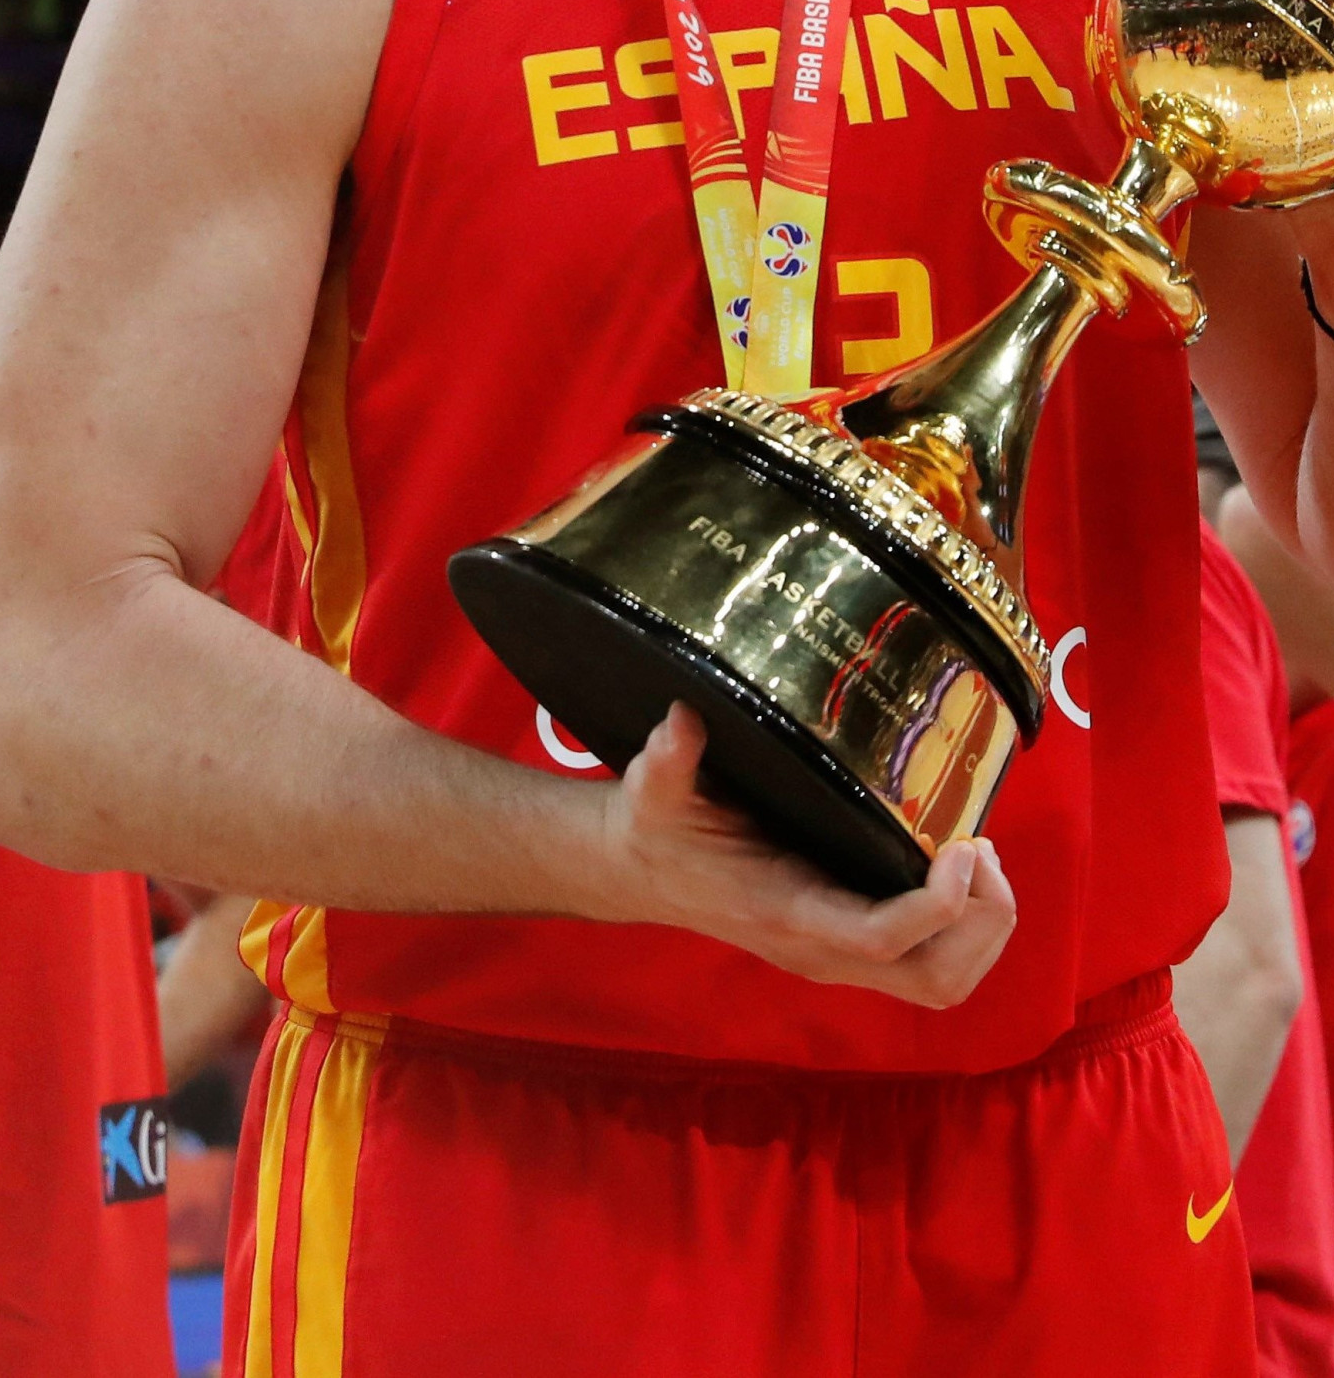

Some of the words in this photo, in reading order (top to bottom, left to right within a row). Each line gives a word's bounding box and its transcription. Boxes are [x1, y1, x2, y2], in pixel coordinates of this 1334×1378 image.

[677, 11, 715, 87] 2019
[794, 54, 824, 104] FIBA
[688, 515, 748, 563] FIBA
[757, 558, 901, 692] ASKETBALL
